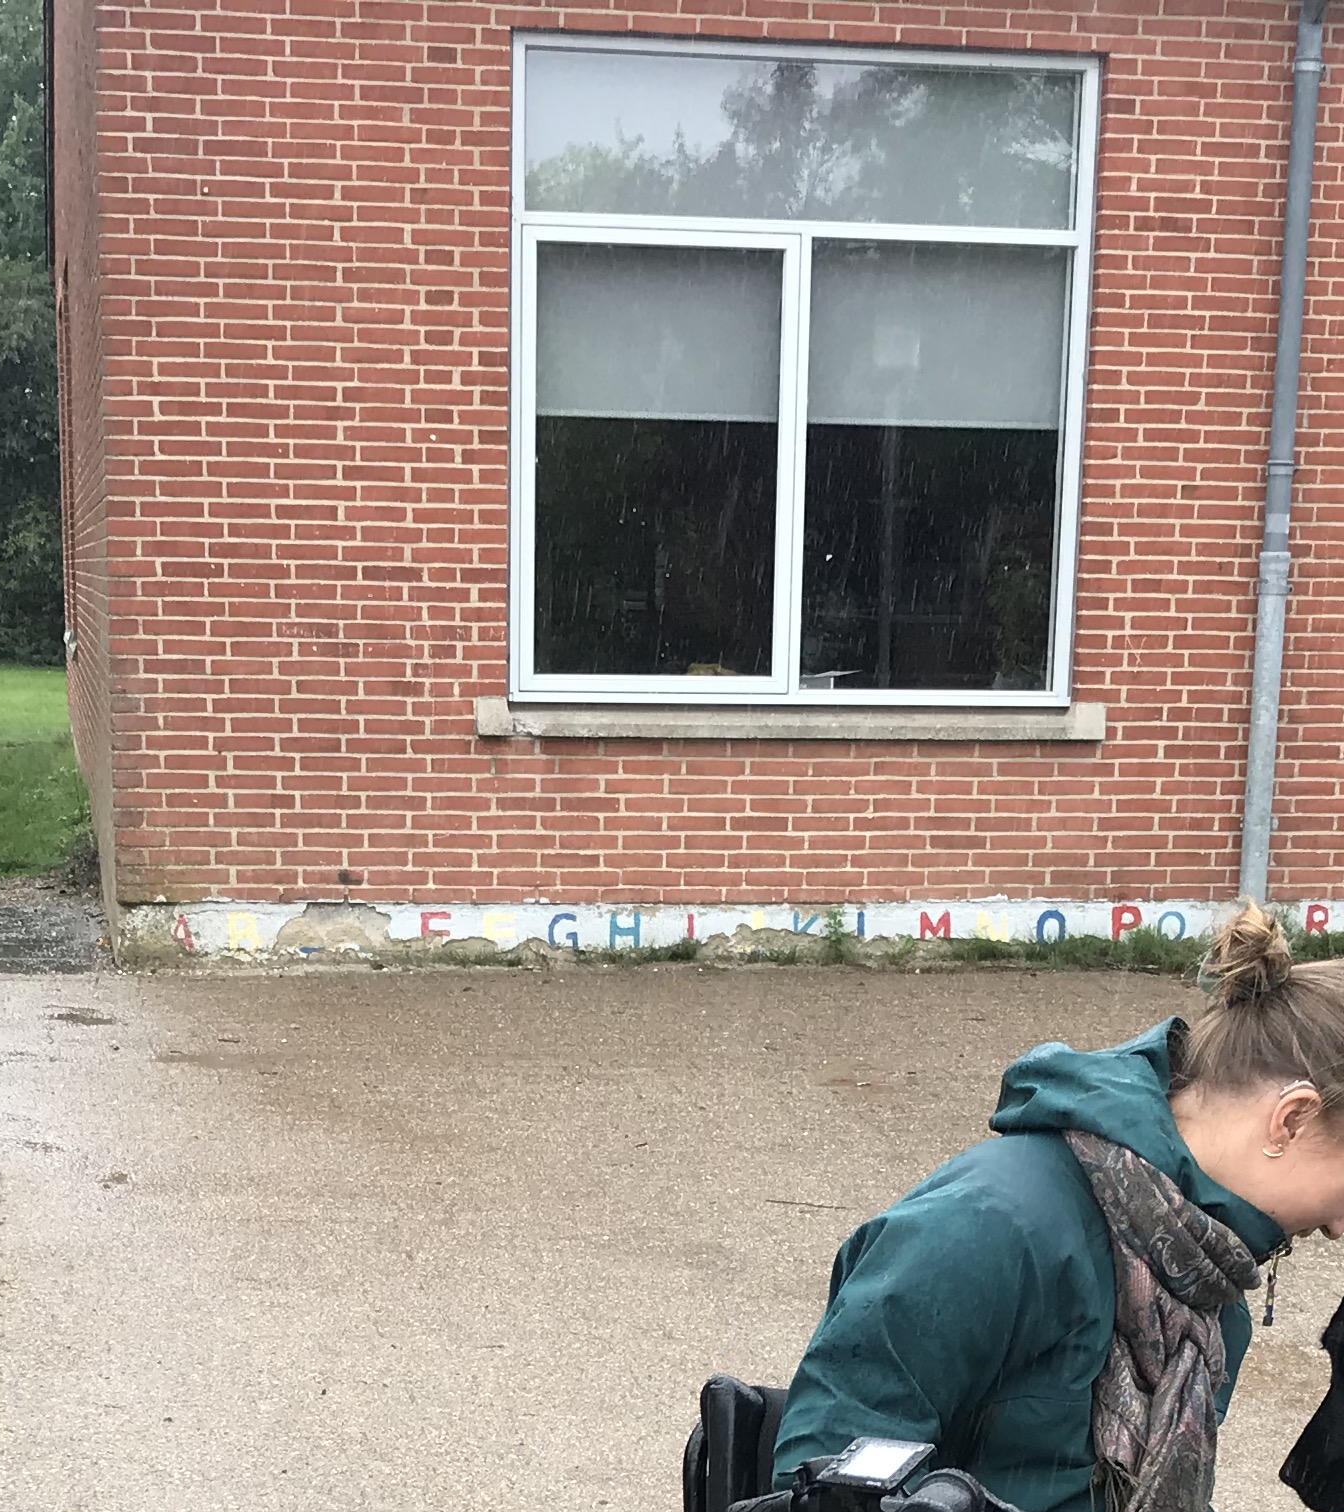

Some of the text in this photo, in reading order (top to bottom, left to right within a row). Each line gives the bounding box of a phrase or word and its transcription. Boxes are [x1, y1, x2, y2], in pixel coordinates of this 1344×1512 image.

[548, 913, 579, 949] G
[610, 911, 641, 948] H
[920, 910, 950, 939] M
[976, 910, 1008, 942] N
[1036, 909, 1066, 945] O
[1111, 904, 1143, 941] P
[1306, 904, 1329, 935] R
